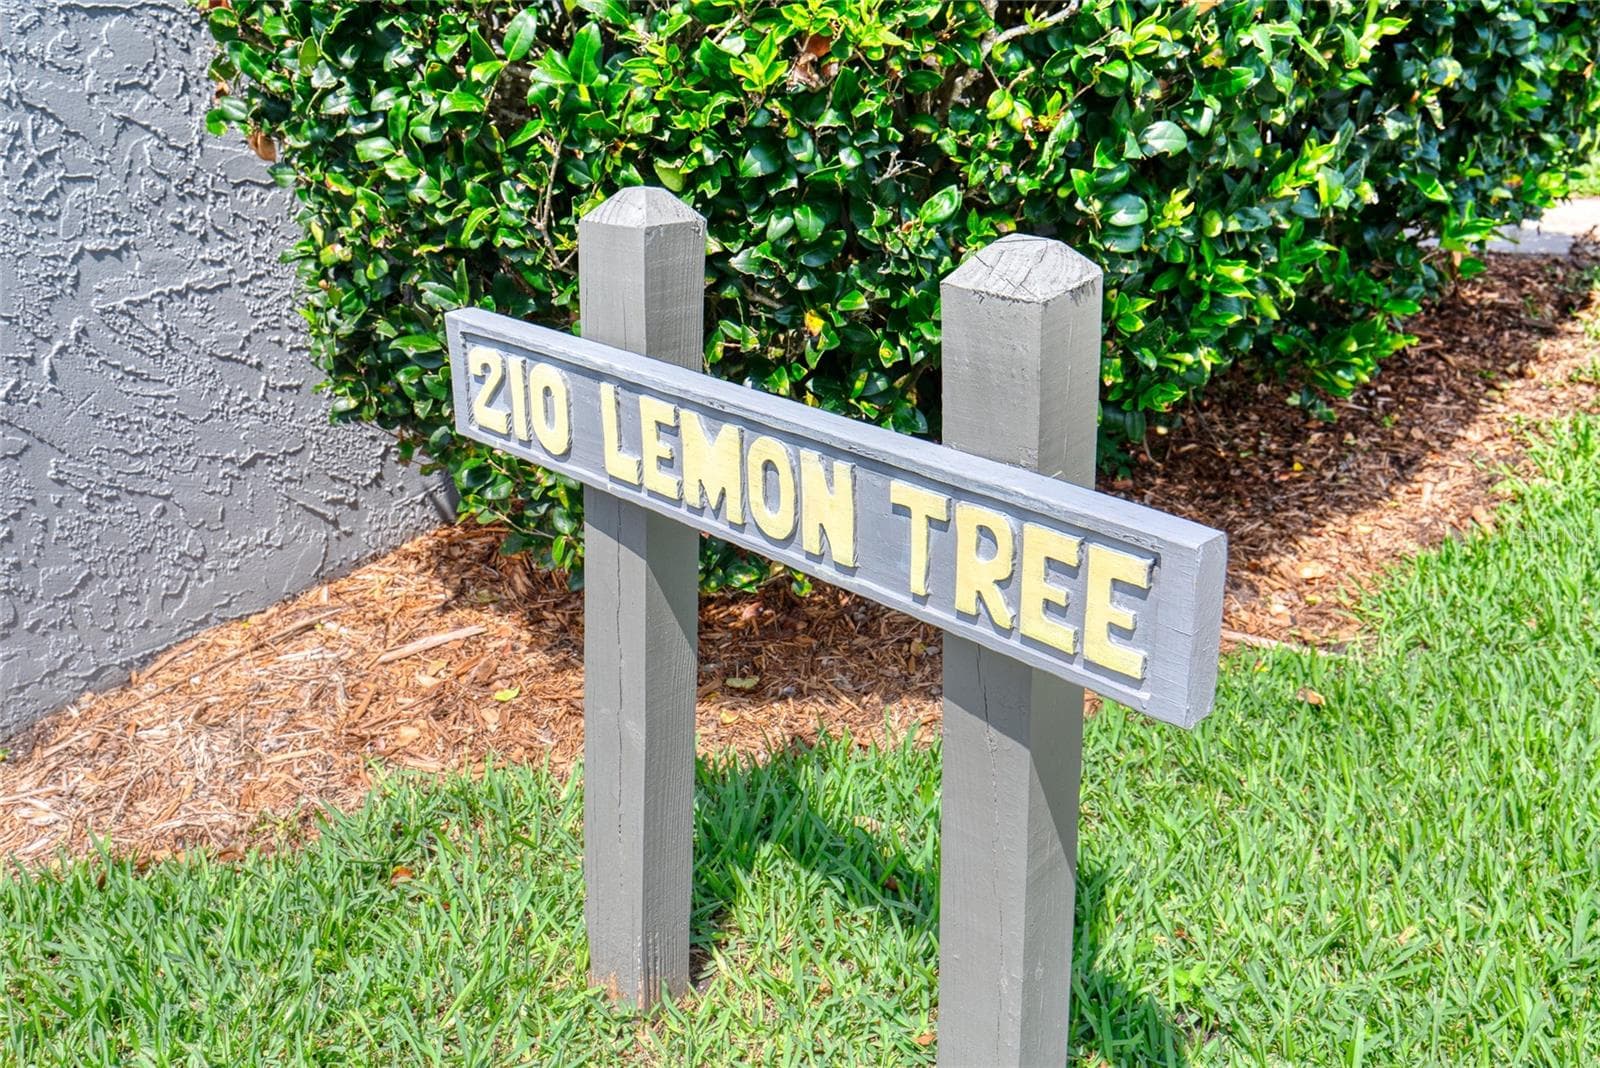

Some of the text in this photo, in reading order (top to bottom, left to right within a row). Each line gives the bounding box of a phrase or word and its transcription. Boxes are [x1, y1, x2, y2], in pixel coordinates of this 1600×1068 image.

[467, 347, 1153, 679] 210 LEMON TREE
